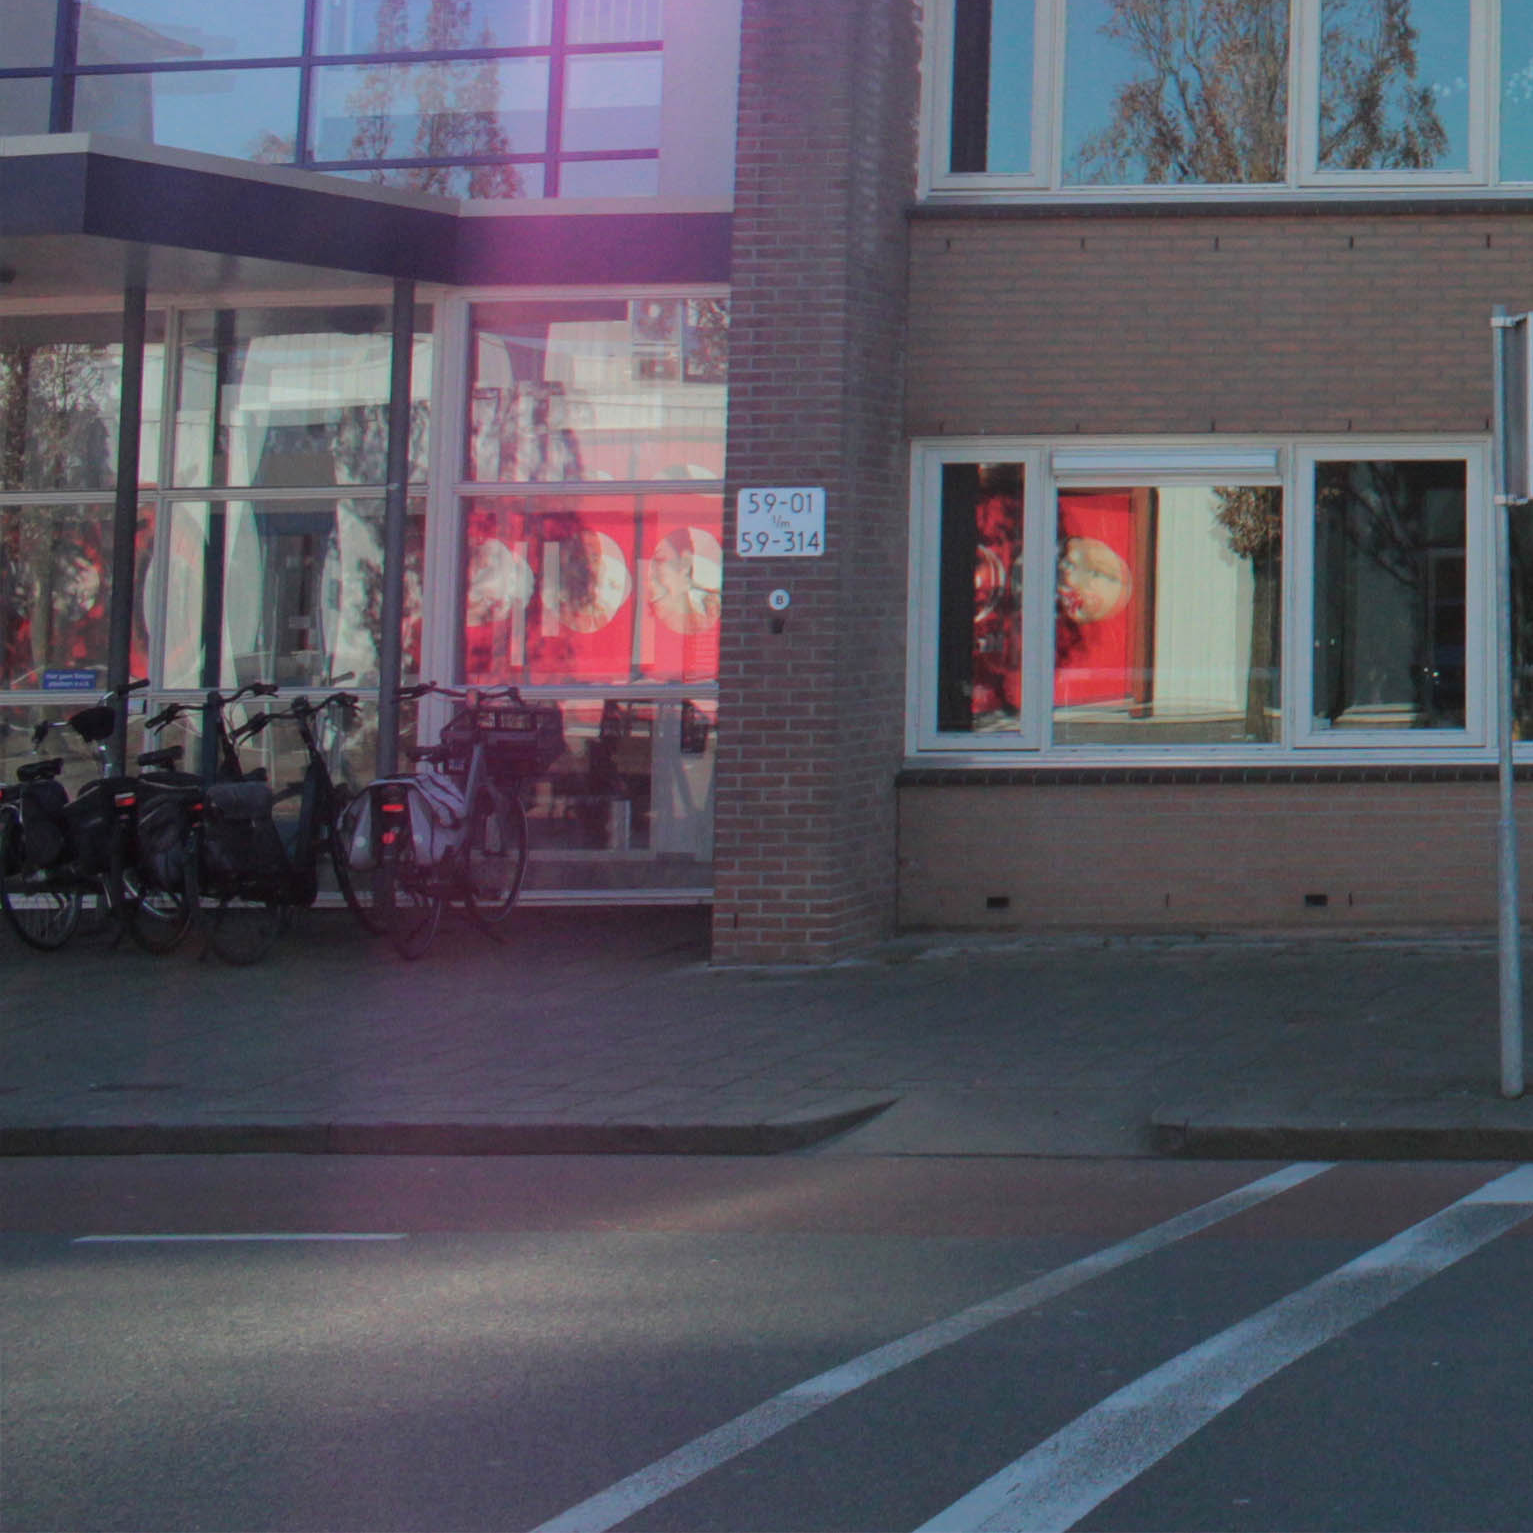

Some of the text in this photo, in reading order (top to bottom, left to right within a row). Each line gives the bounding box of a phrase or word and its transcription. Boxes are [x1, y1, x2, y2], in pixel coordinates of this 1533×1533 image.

[748, 493, 813, 514] 59-01
[741, 531, 820, 553] 59-314
[775, 595, 784, 605] B
